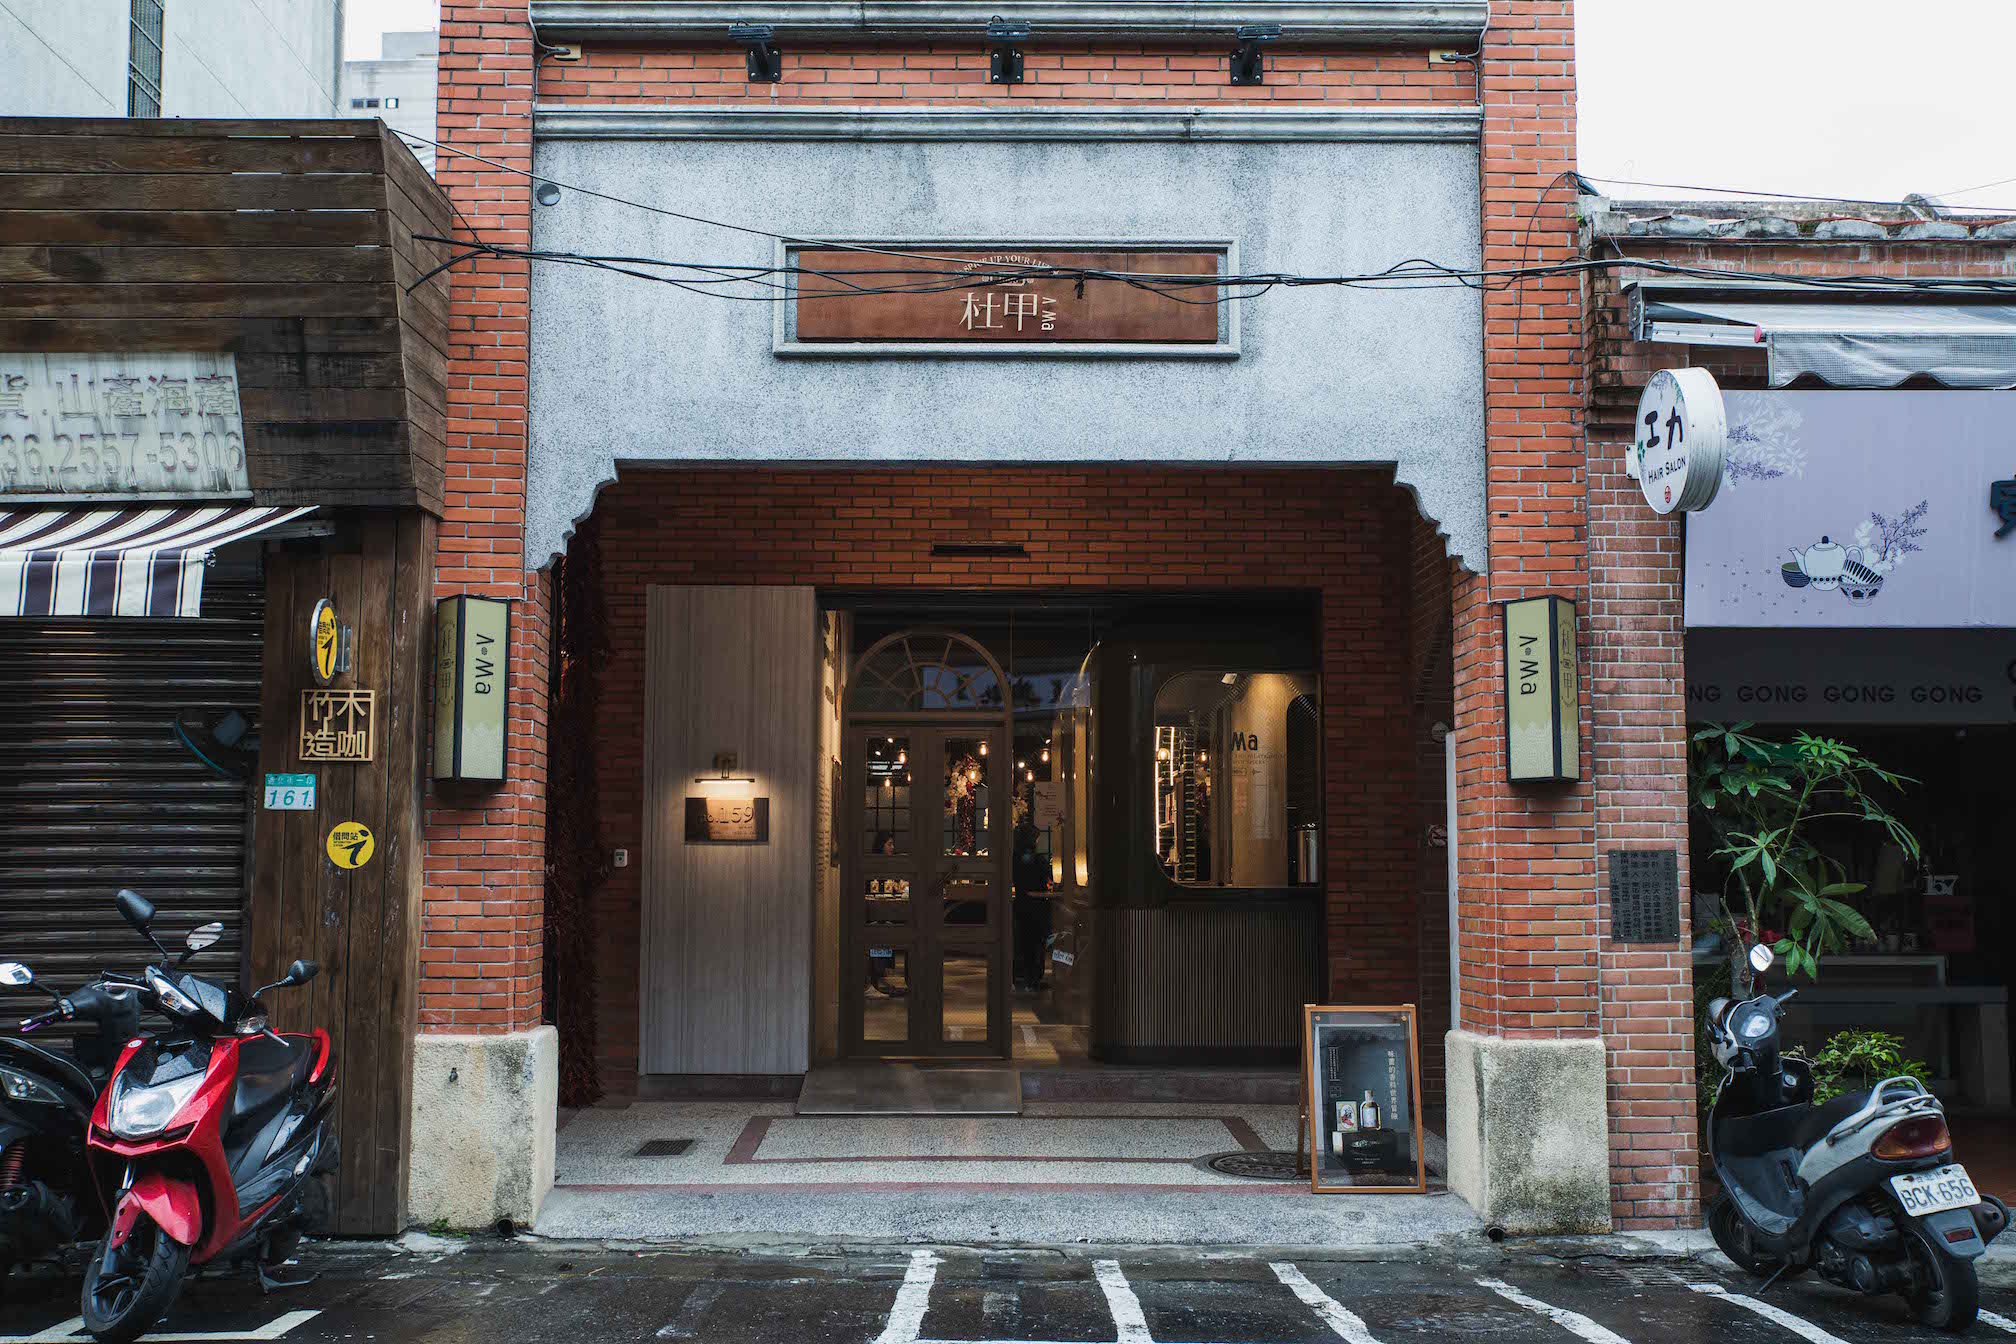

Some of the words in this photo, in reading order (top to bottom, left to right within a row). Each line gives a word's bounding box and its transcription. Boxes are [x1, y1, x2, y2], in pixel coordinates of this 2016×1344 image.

[958, 292, 1039, 332] 杜甲
[1665, 455, 1687, 476] SALON
[1736, 684, 1809, 704] GONG
[1823, 684, 1896, 704] GONG
[1910, 684, 1984, 704] GONG
[269, 789, 310, 806] 161
